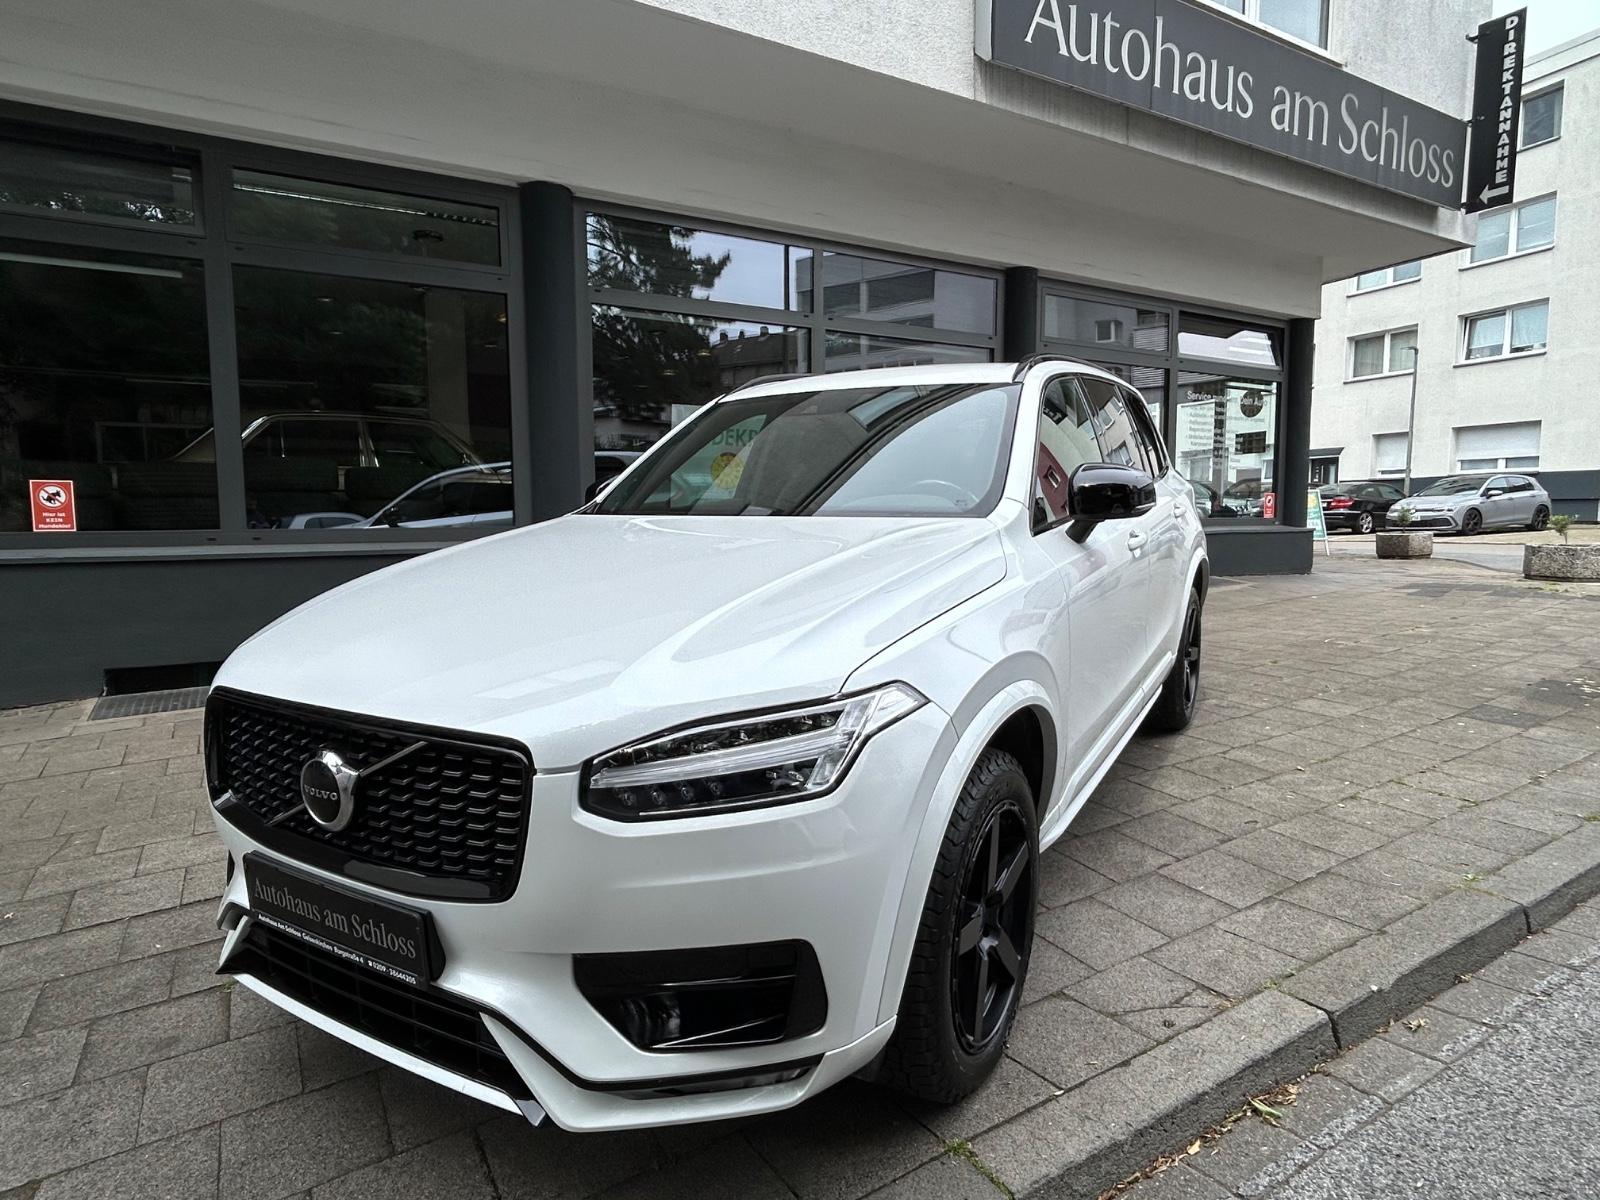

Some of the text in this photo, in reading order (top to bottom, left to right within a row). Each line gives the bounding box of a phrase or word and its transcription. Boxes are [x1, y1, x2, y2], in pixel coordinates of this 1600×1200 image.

[1025, 0, 1454, 189] Autohaus am Schloss
[1495, 15, 1519, 184] DIREKTANNAHME
[1187, 390, 1212, 402] Service
[304, 784, 338, 801] VOLVO
[255, 878, 417, 959] Autohaus am Schloss
